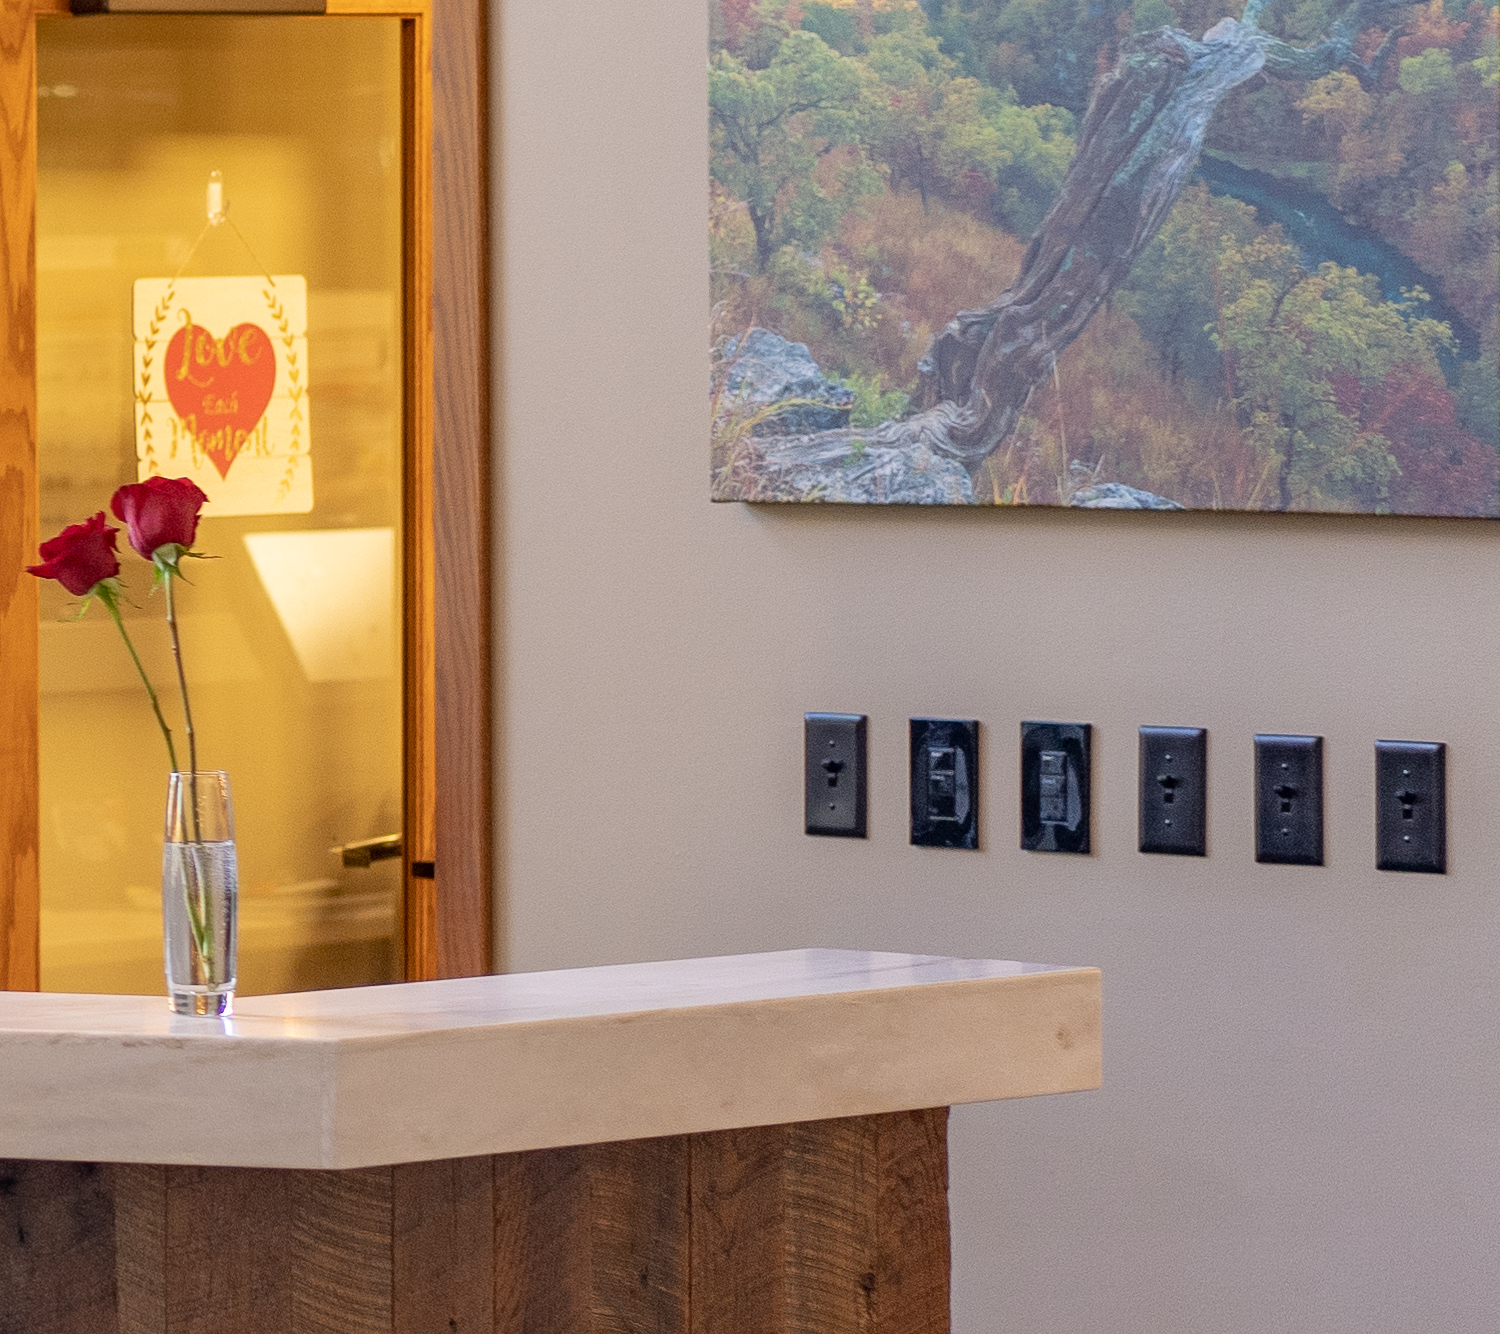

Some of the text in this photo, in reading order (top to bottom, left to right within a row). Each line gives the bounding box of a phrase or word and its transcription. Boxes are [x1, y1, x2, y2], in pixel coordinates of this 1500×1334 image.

[176, 308, 263, 388] Love
[202, 390, 238, 415] Each
[166, 413, 276, 470] Moment
